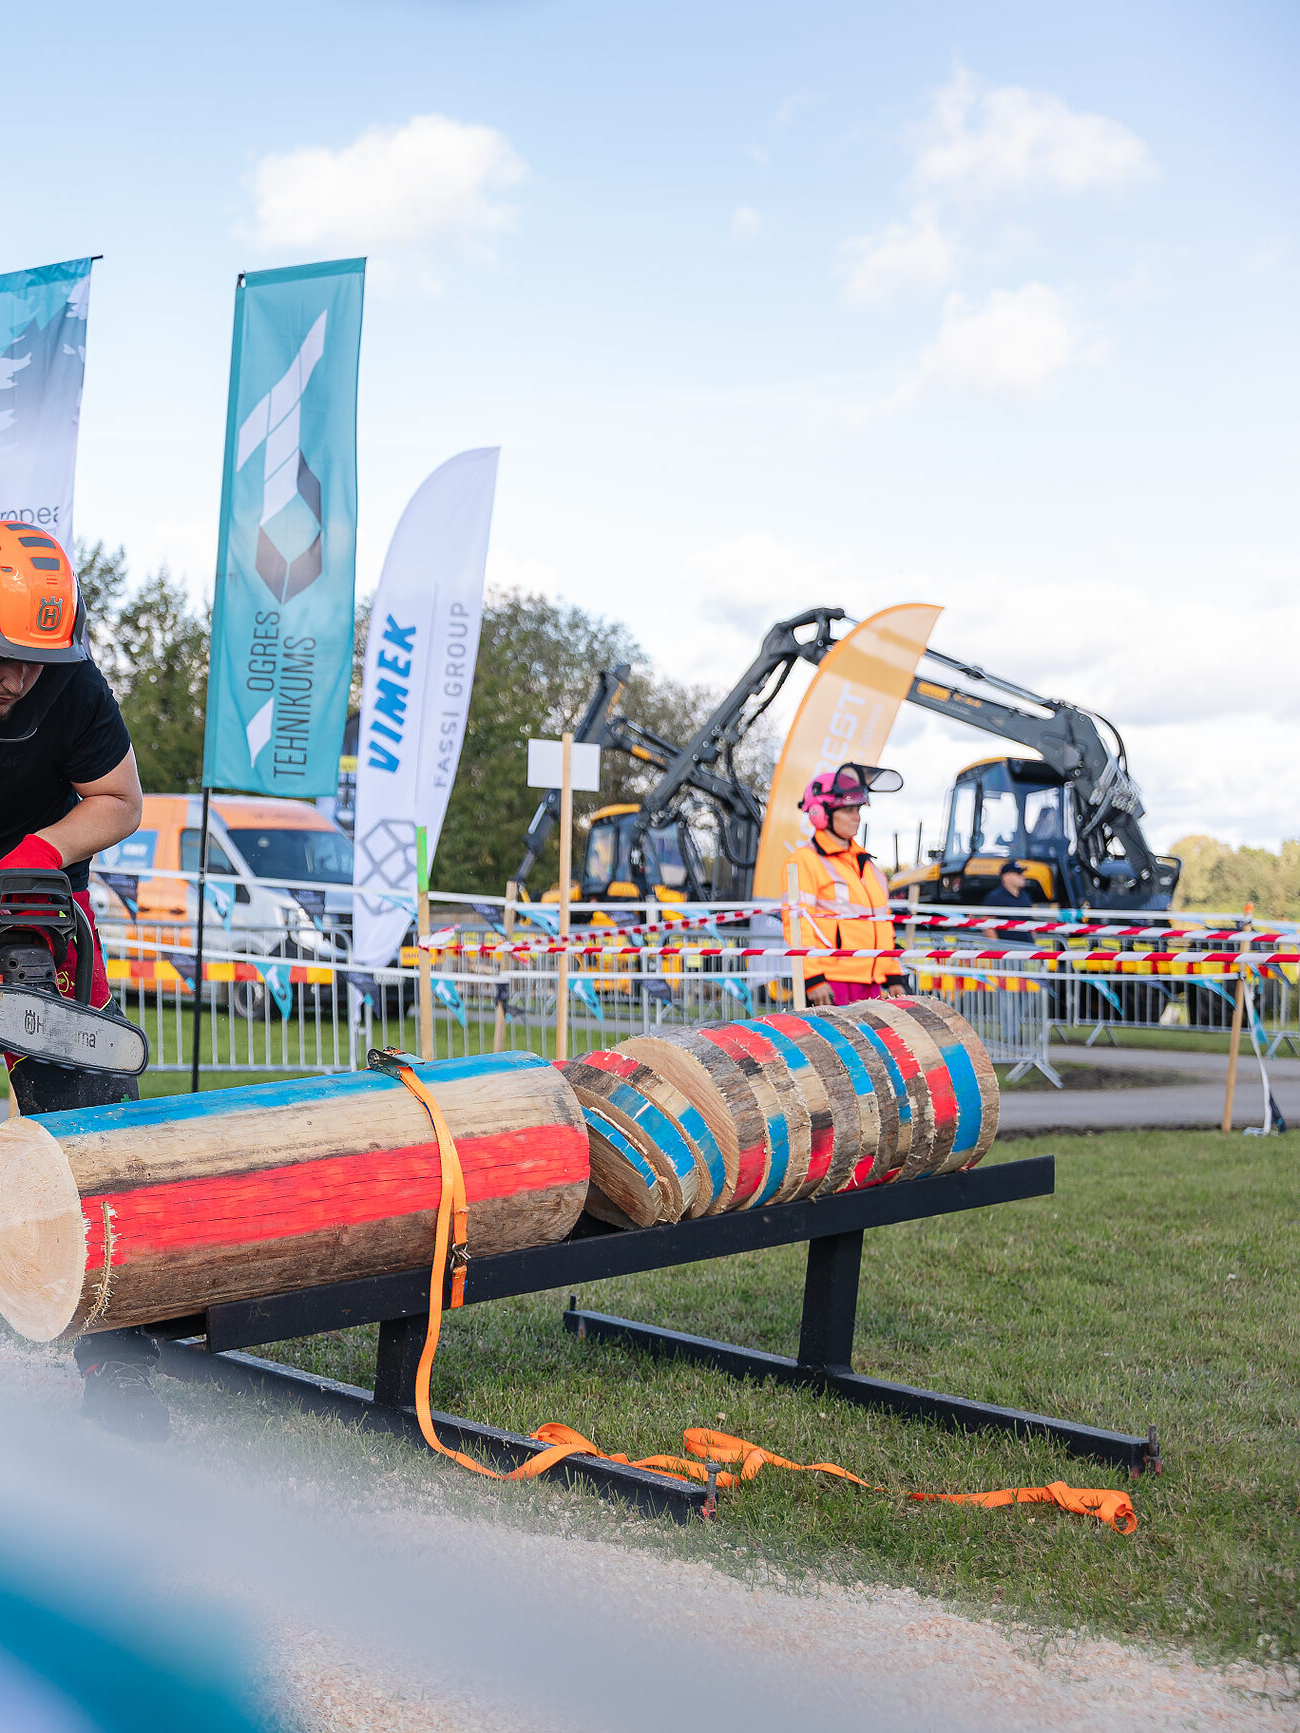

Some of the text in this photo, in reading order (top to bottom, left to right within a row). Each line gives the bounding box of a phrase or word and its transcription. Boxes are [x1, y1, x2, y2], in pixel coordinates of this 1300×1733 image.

[246, 611, 281, 692] OGRES
[273, 635, 316, 779] TEHNIKUMS
[368, 613, 417, 773] VIMEK
[434, 602, 469, 788] FASSI GROUP
